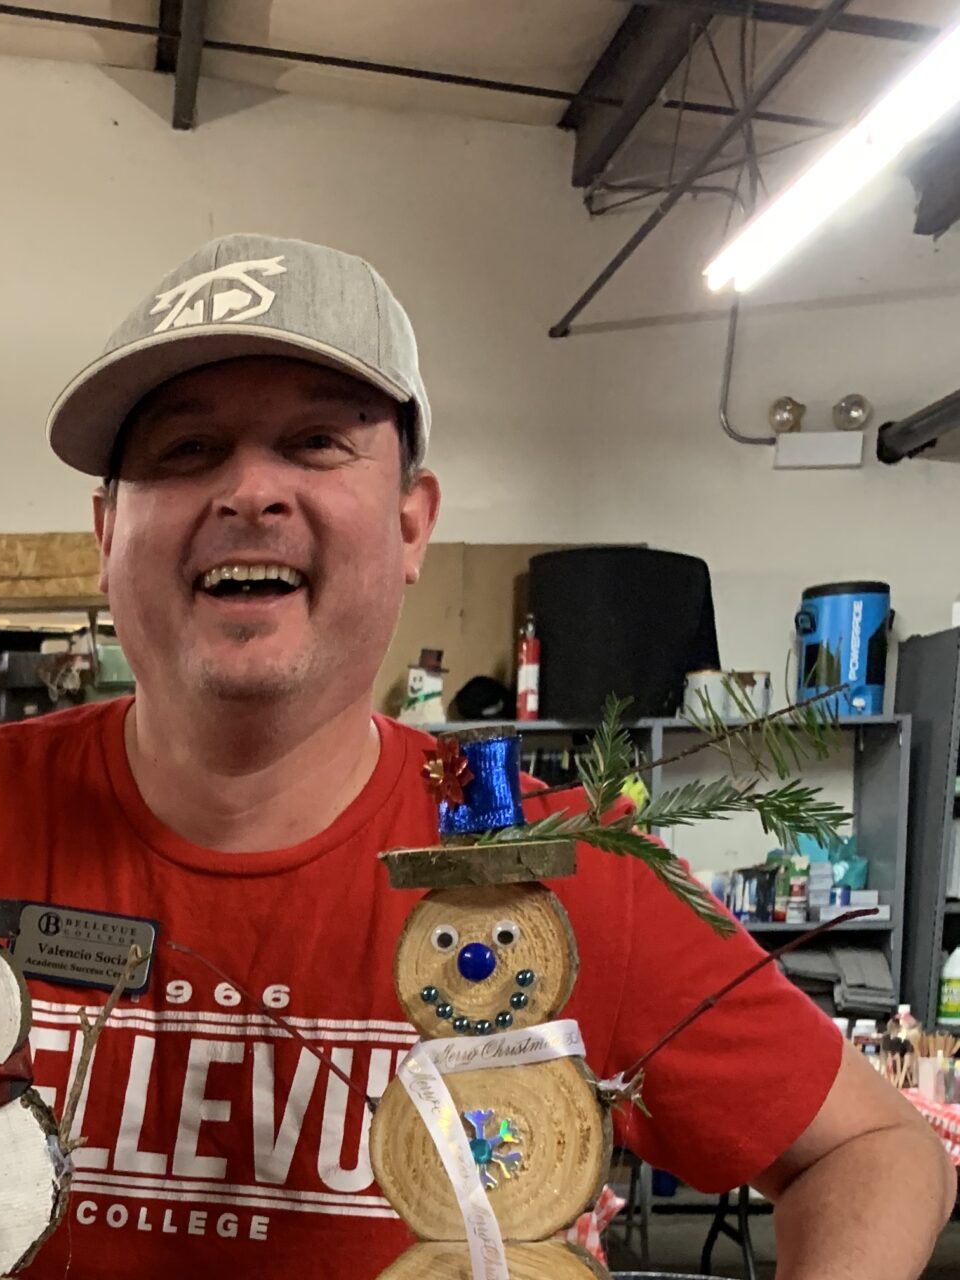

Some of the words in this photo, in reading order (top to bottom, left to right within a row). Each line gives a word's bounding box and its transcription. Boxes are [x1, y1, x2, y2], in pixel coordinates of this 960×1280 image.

[65, 918, 137, 936] BELLEVUE
[64, 930, 135, 944] COLLEGE
[38, 943, 92, 961] Valencio
[25, 957, 68, 971] Academic
[70, 962, 104, 976] Success
[131, 979, 291, 1009] 966
[27, 1026, 418, 1193] ELLEVU
[76, 1201, 270, 1240] COLLEGE
